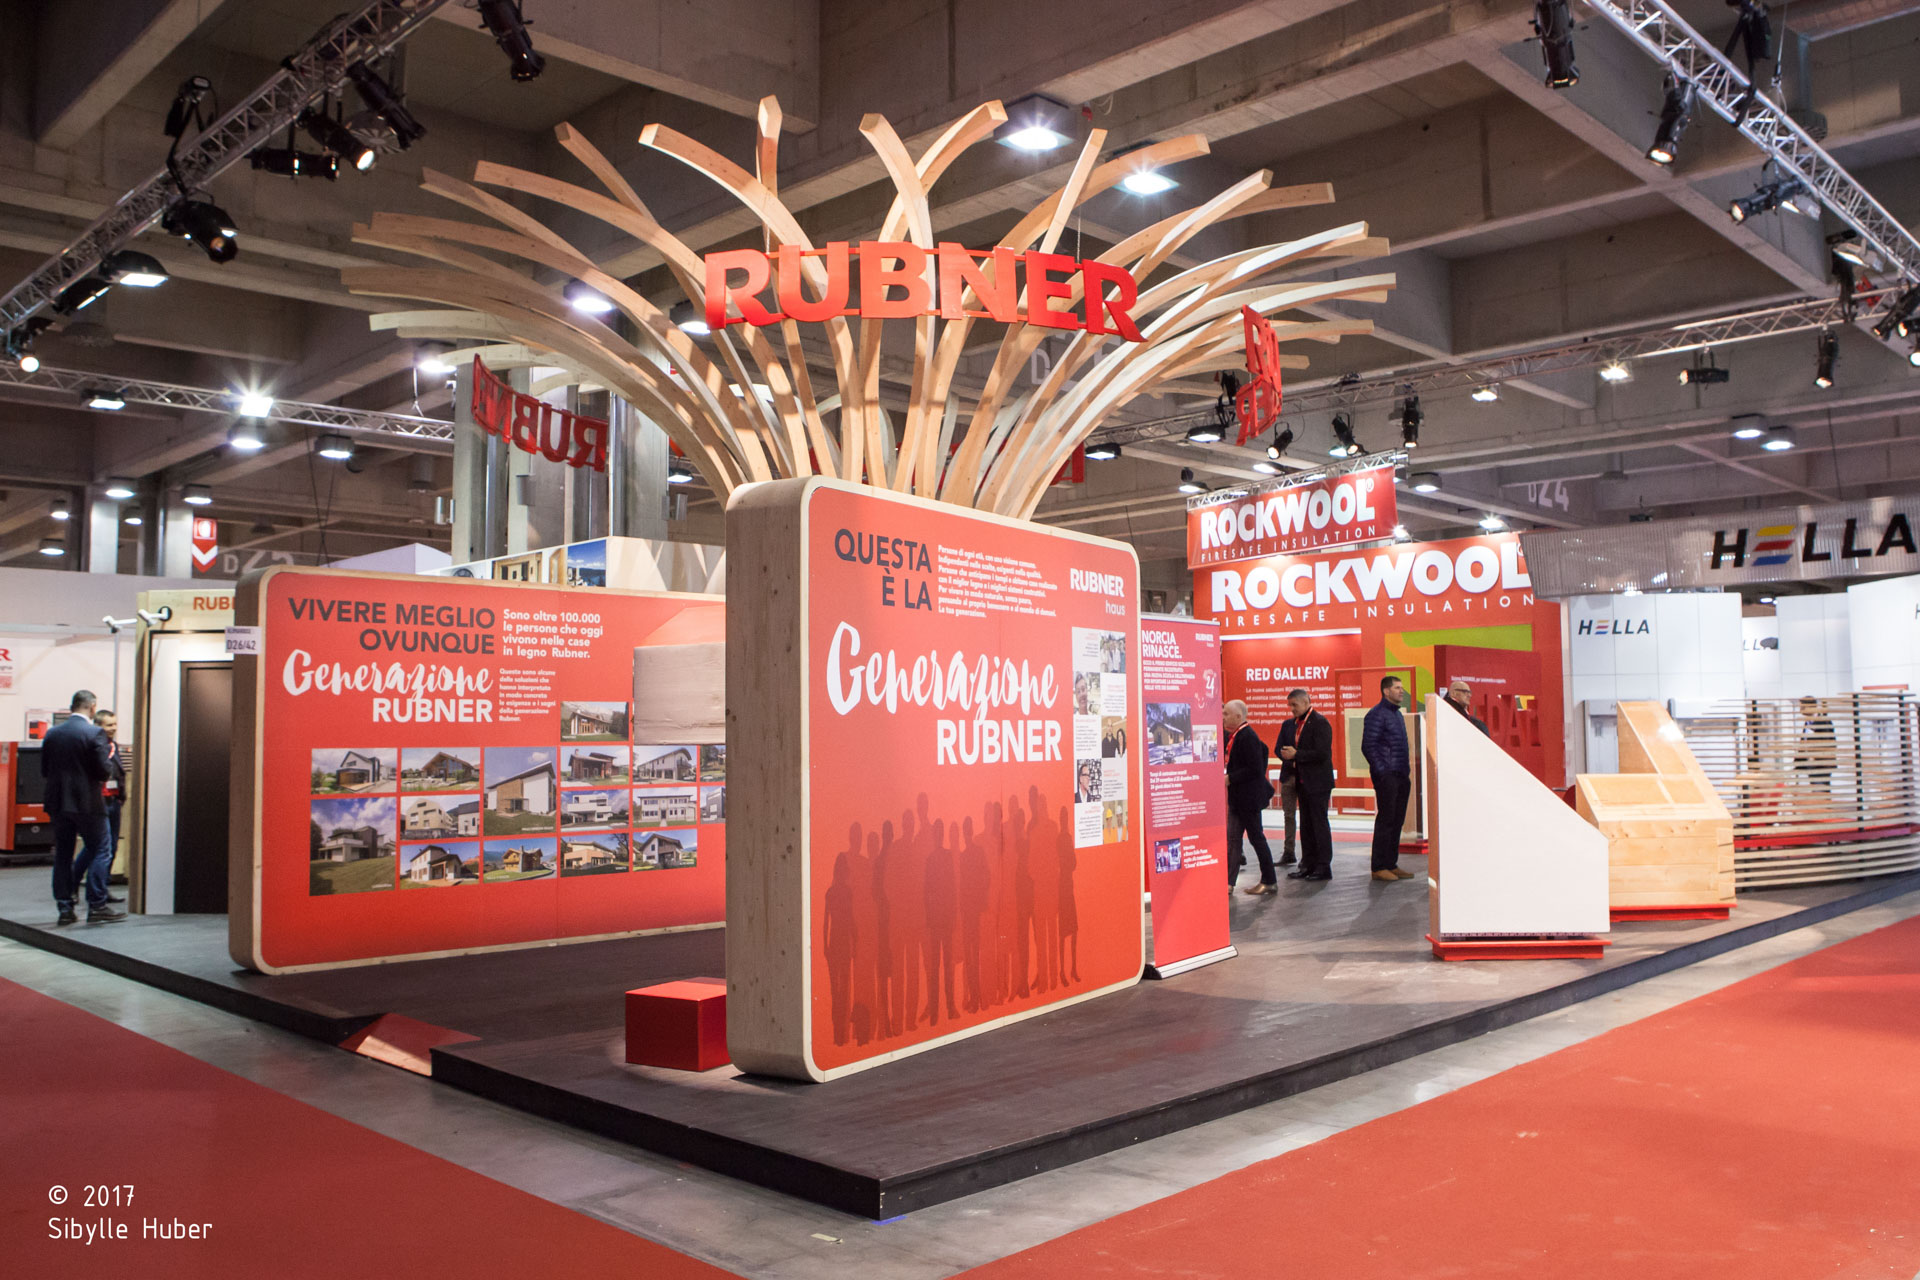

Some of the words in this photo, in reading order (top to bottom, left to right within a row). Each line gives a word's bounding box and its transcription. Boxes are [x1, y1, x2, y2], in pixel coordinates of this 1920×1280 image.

[705, 241, 1148, 342] RUBNER
[834, 528, 932, 573] QUESTA
[1201, 544, 1262, 563] FIRESAFE
[1273, 525, 1376, 552] INSULATION
[882, 568, 896, 607] È
[905, 580, 932, 612] LA
[1070, 567, 1125, 598] RUBNER
[288, 597, 386, 625] VIVERE
[395, 603, 495, 629] MEGLIO
[503, 609, 530, 620] Sono
[533, 610, 557, 622] oltre
[560, 612, 600, 623] 100.000
[1105, 600, 1126, 616] haus
[1353, 593, 1536, 619] INSULATION
[359, 628, 495, 655] OVUNQUE
[502, 633, 538, 644] vivono
[541, 635, 565, 646] nelle
[568, 638, 590, 647] case
[503, 621, 513, 631] le
[516, 624, 558, 634] persone
[560, 624, 578, 634] che
[580, 626, 603, 638] oggi
[1141, 629, 1177, 645] NORCIA
[503, 646, 513, 656] in
[517, 646, 547, 659] legno
[552, 647, 591, 659] Rubner.
[1142, 643, 1183, 659] RINASCE.
[282, 648, 494, 702] Generazione
[826, 620, 1059, 726] Generazione
[1246, 668, 1271, 681] RED
[1273, 666, 1330, 680] GALLERY
[373, 698, 493, 723] RUBNER
[937, 719, 1062, 765] RUBNER
